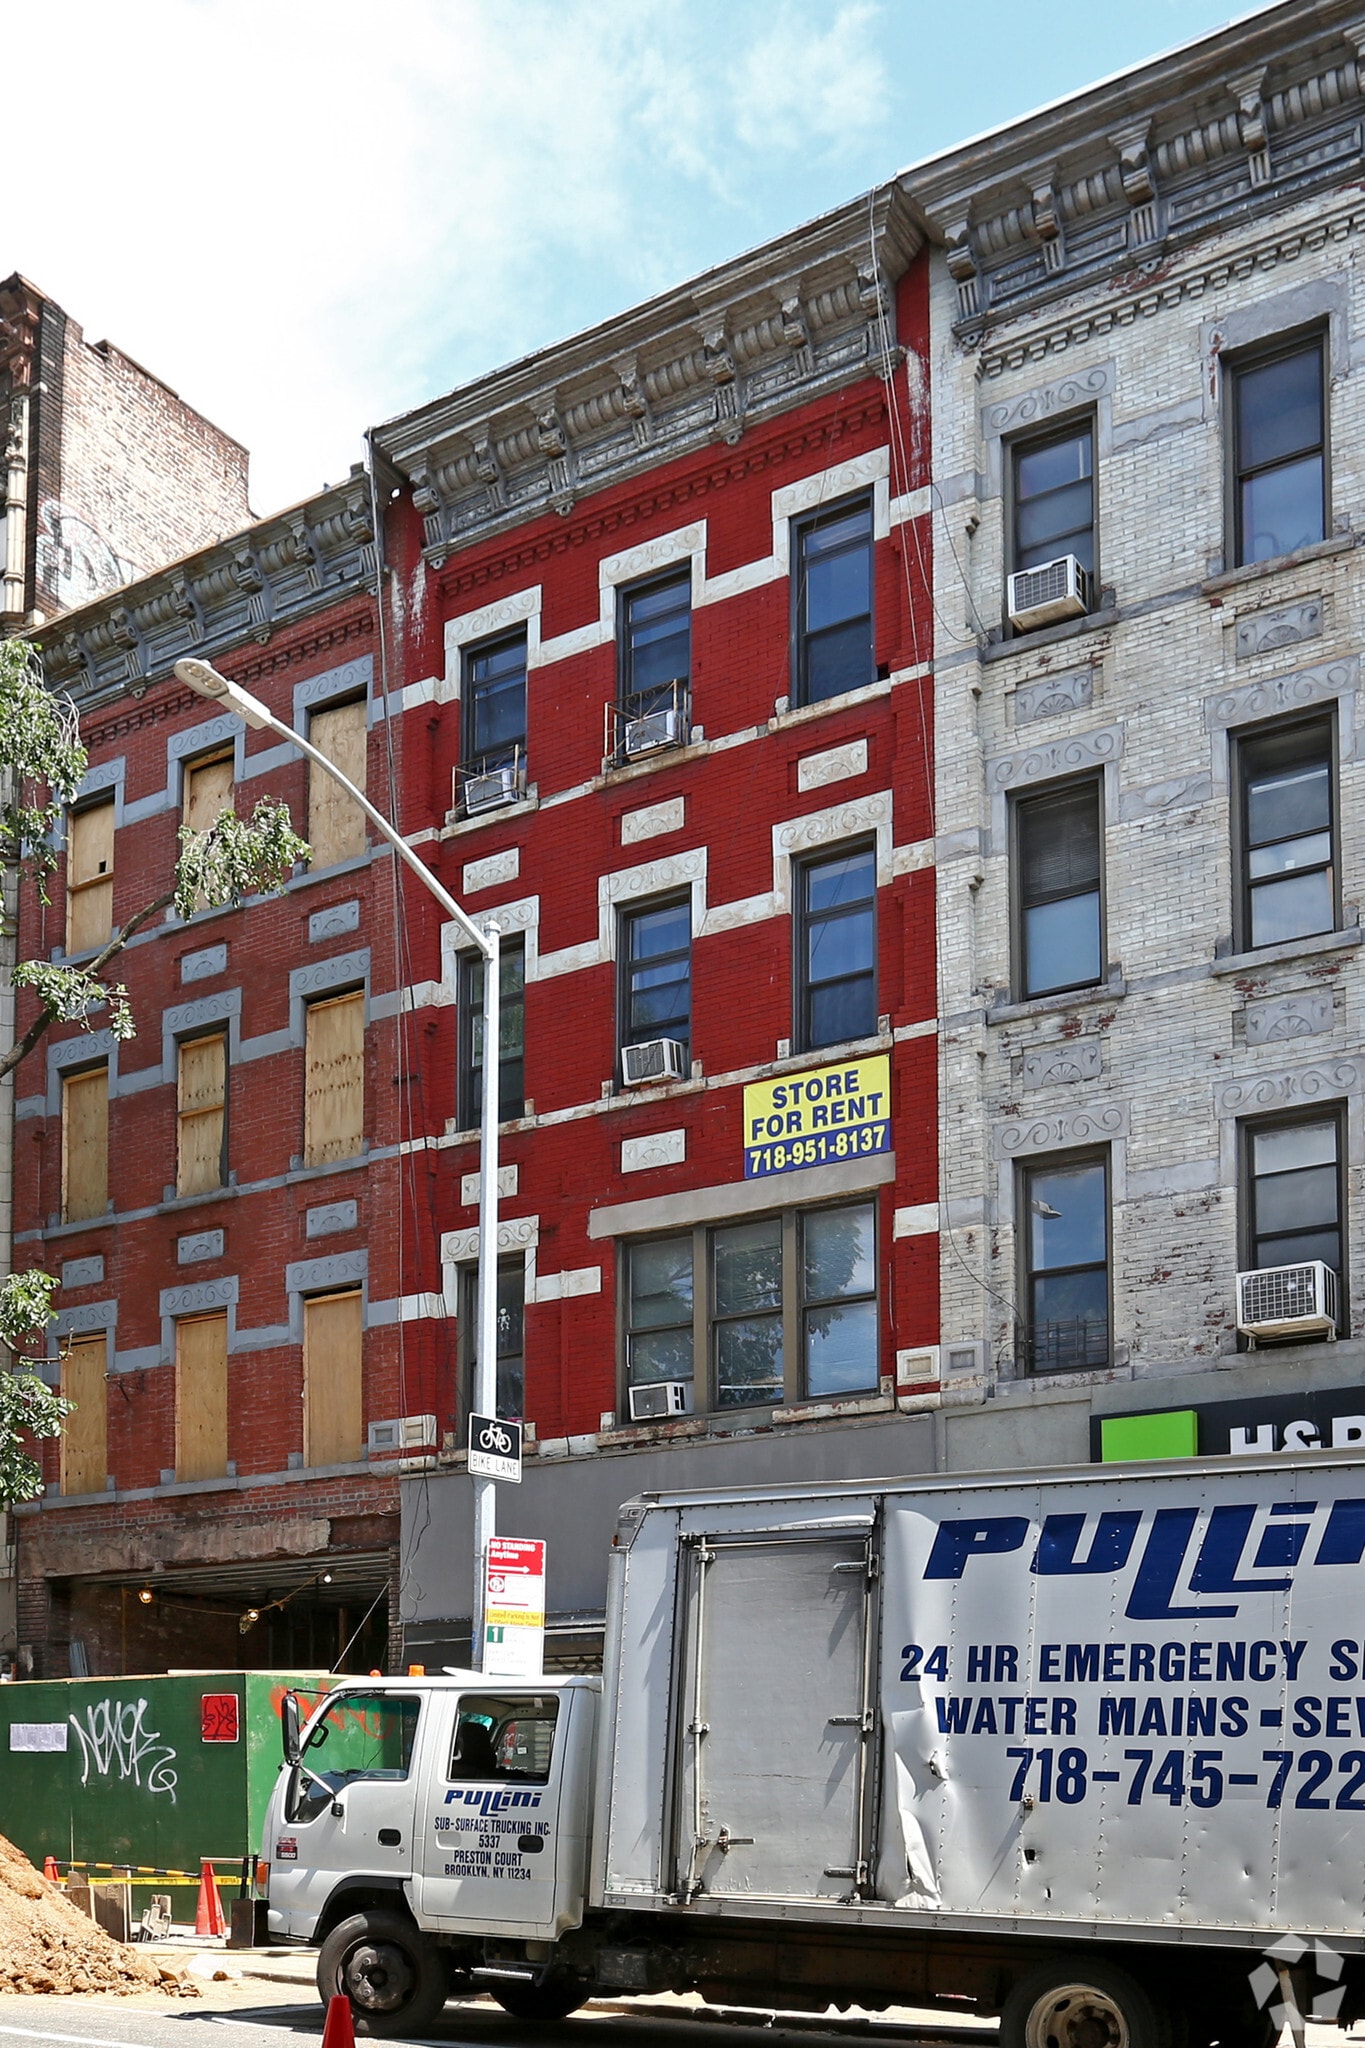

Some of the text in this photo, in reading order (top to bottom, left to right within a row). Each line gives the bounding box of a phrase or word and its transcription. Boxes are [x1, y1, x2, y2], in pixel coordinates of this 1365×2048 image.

[772, 1069, 859, 1109] STORE
[751, 1092, 883, 1141] FOR RENT
[750, 1125, 886, 1173] 718-951-8137
[472, 1454, 517, 1476] BIKE LANE
[490, 1541, 536, 1552] NO STANDING
[490, 1550, 519, 1560] Anytime
[900, 1644, 949, 1682] 24
[967, 1645, 1019, 1682] HR
[1039, 1641, 1308, 1682] EMERGENCY
[935, 1697, 1077, 1736] WATER
[434, 1816, 551, 1836] SUB-SURFACE TRUCKING INC.
[478, 1834, 501, 1848] 5337
[454, 1850, 523, 1866] PRESTON COURT
[493, 1868, 504, 1878] NY
[508, 1868, 531, 1880] 11234
